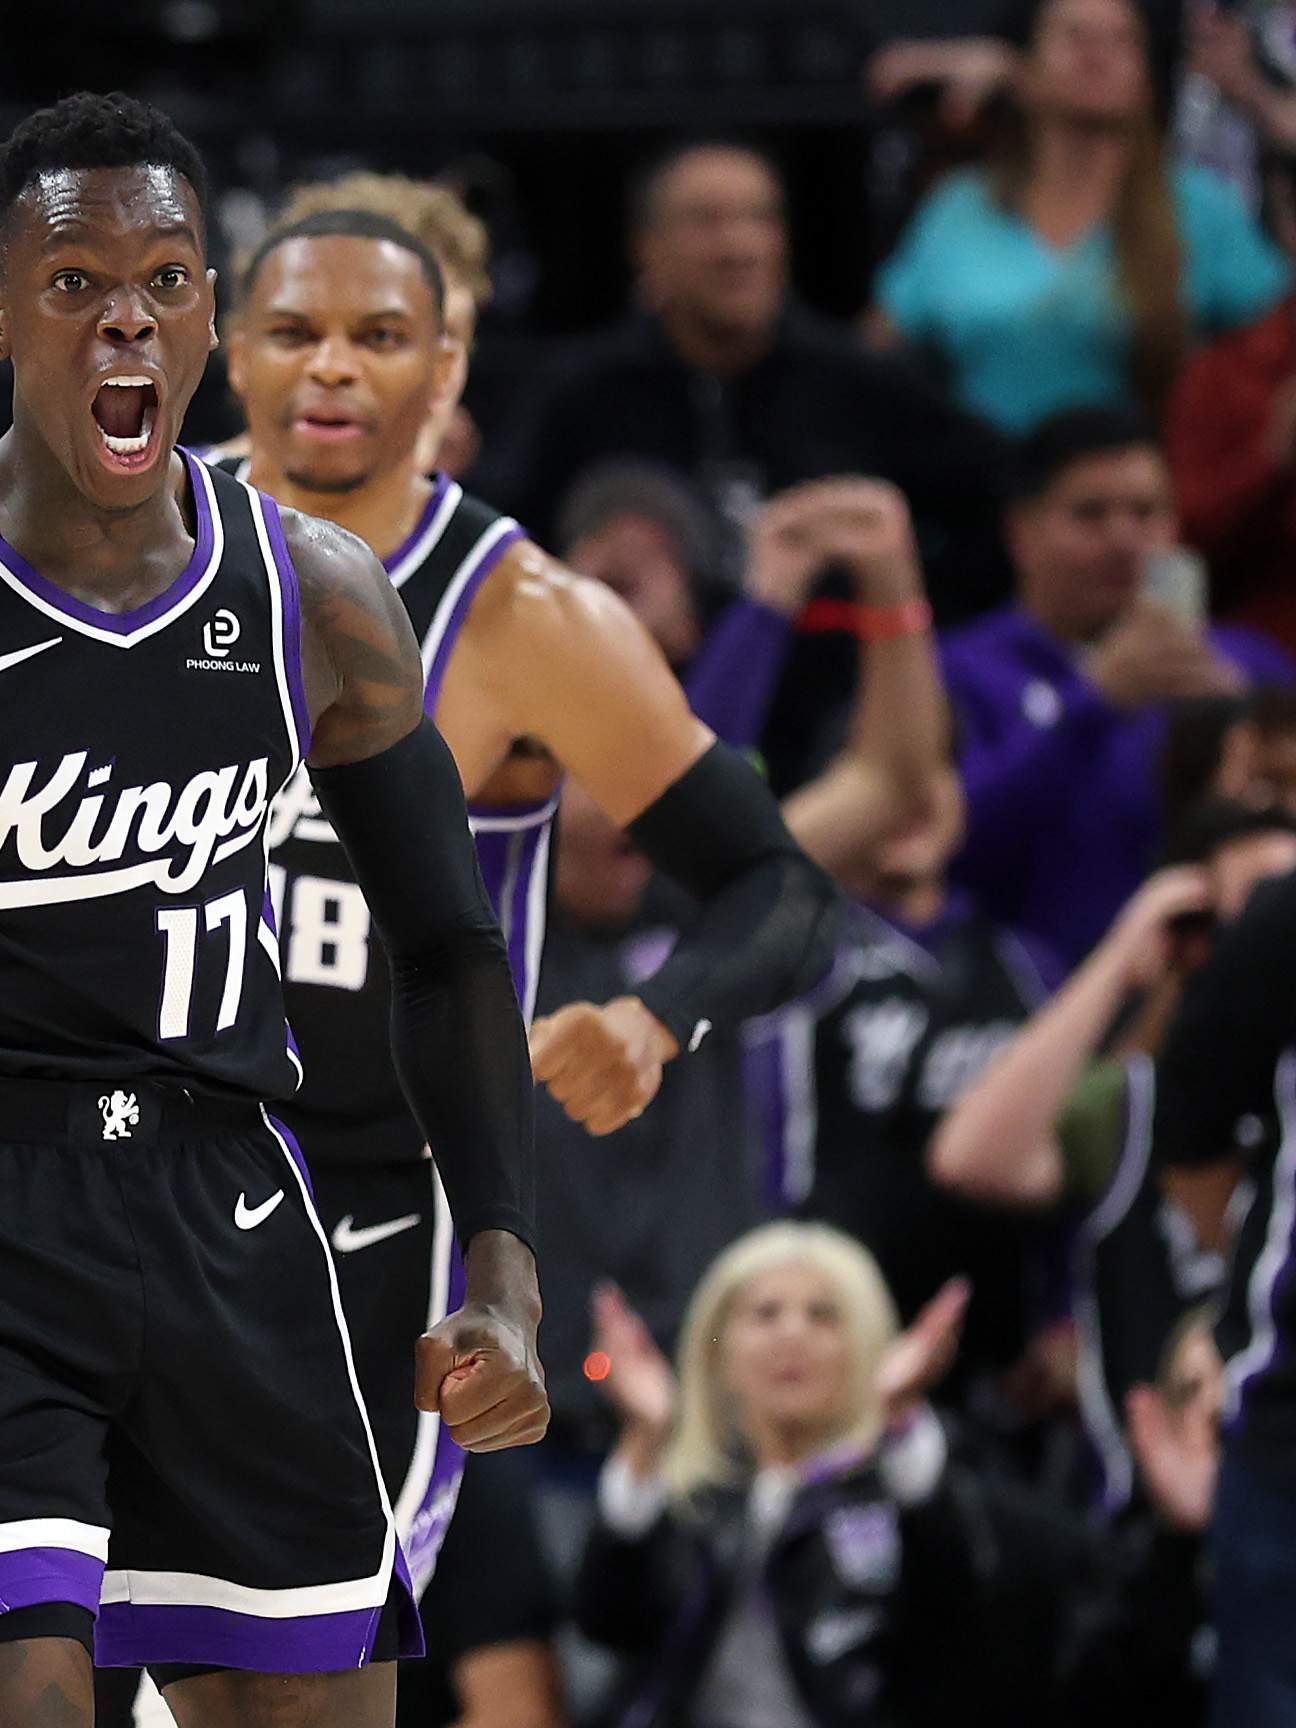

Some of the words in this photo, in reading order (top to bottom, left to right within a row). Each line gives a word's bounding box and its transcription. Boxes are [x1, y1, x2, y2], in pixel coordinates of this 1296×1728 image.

[186, 659, 235, 671] PHOONG
[235, 661, 260, 673] LAW
[157, 888, 247, 1040] 17
